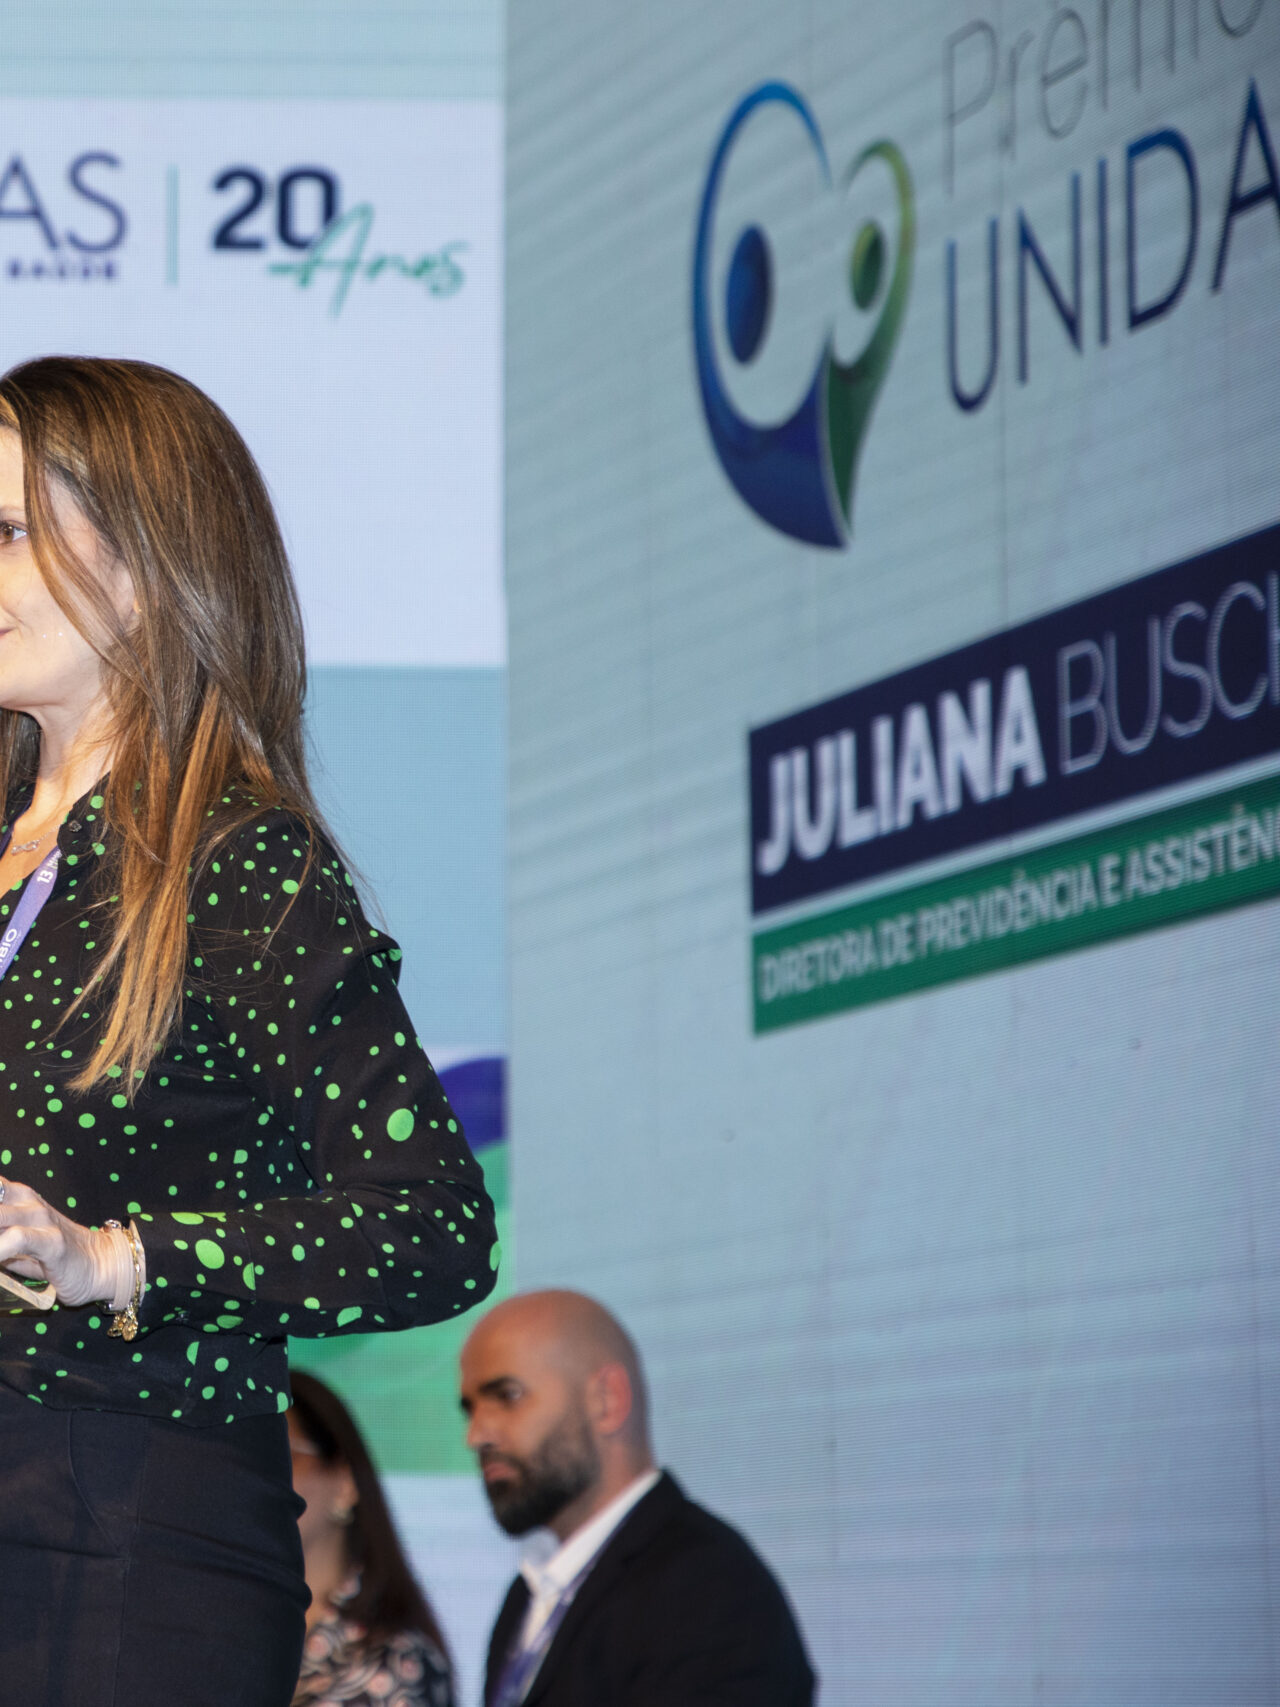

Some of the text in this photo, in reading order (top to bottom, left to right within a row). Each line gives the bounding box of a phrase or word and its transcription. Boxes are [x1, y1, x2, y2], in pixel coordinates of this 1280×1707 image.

[211, 164, 340, 251] 20
[266, 202, 470, 316] Anos
[946, 77, 1280, 415] UNIDA
[757, 666, 1047, 877] JULIANA
[37, 869, 54, 884] 13
[759, 802, 1280, 1003] DIRETORA DE PREVIDÊNCIA E ASSISTÊN
